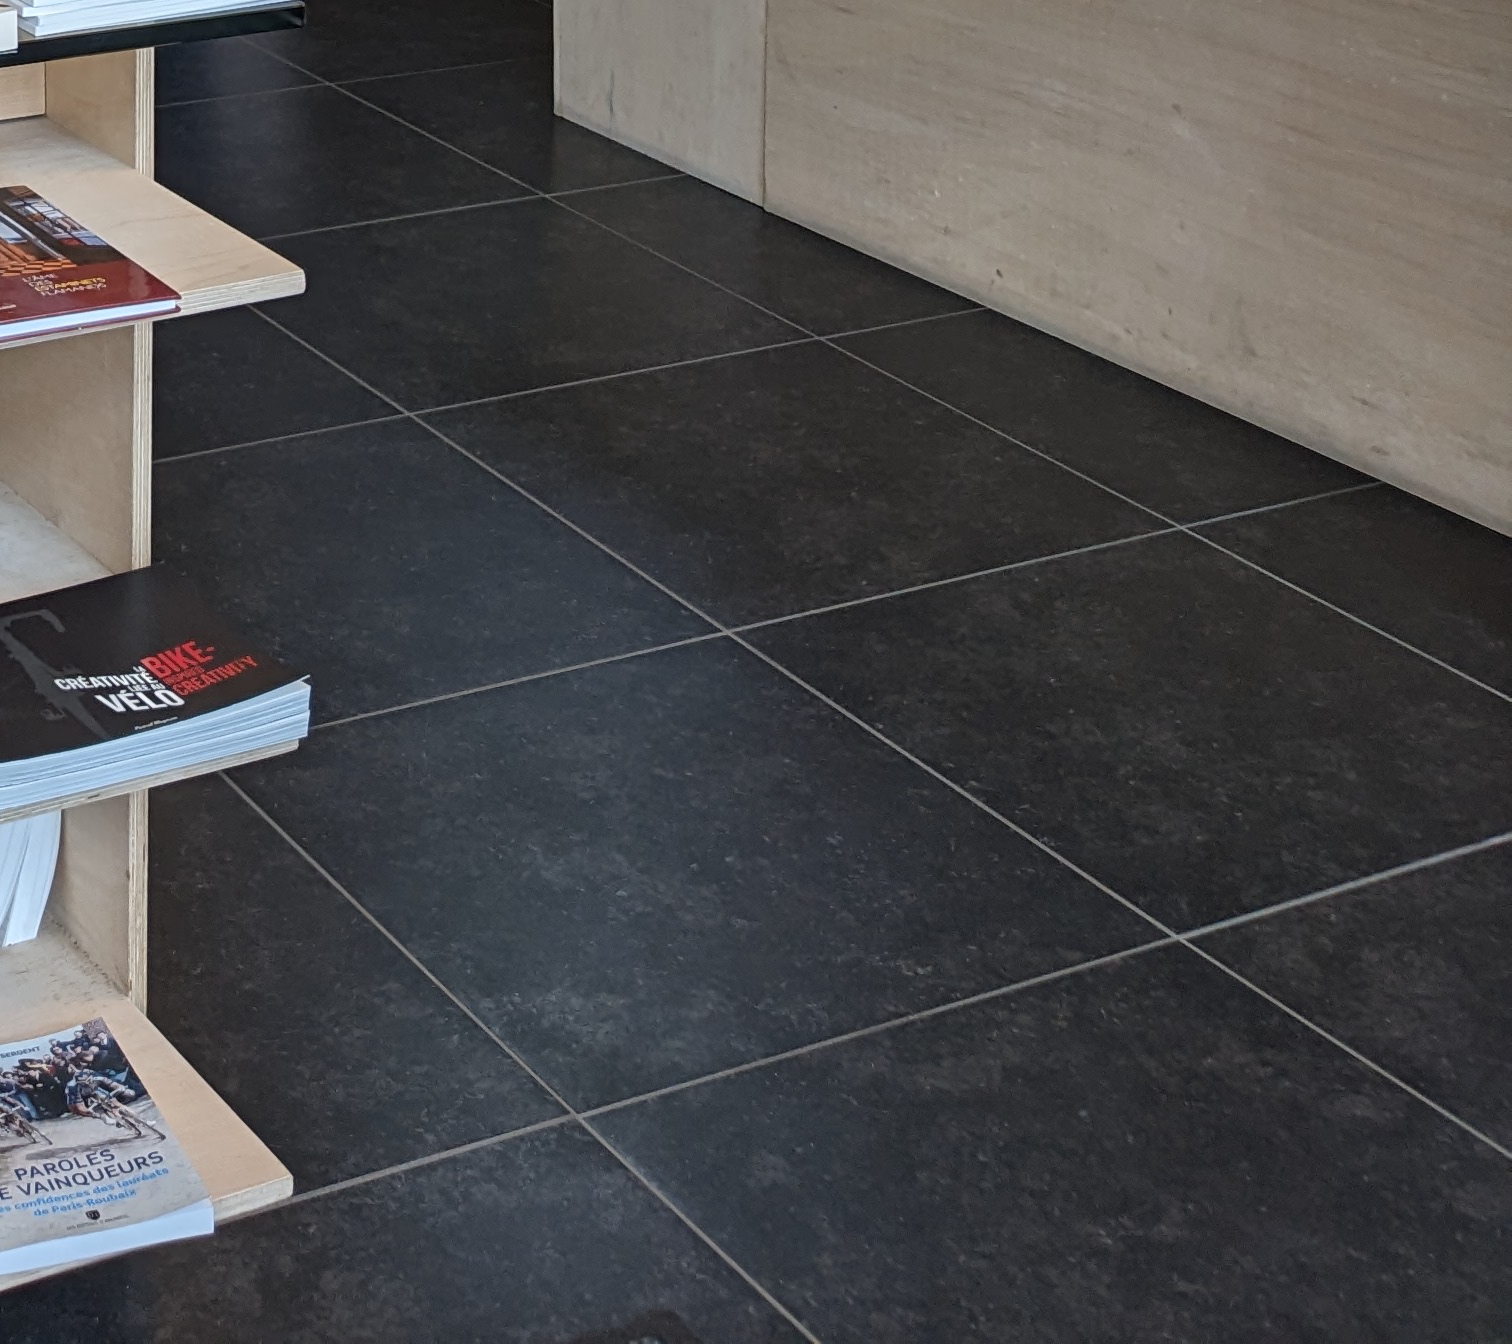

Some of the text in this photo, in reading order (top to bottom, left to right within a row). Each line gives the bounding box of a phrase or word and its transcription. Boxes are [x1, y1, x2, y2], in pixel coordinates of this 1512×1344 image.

[139, 639, 216, 677] BIKE-
[172, 654, 259, 697] CREATIVITY
[53, 671, 159, 691] CRÉATIVITÉ
[93, 689, 186, 713] VÉLO
[13, 1148, 116, 1182] PAROLES
[17, 1150, 165, 1197] VAINQUEURS
[14, 1190, 90, 1211] confidences
[92, 1184, 116, 1195] des
[117, 1166, 170, 1189] lauréats
[33, 1188, 137, 1217] de Paris-Roubaix
